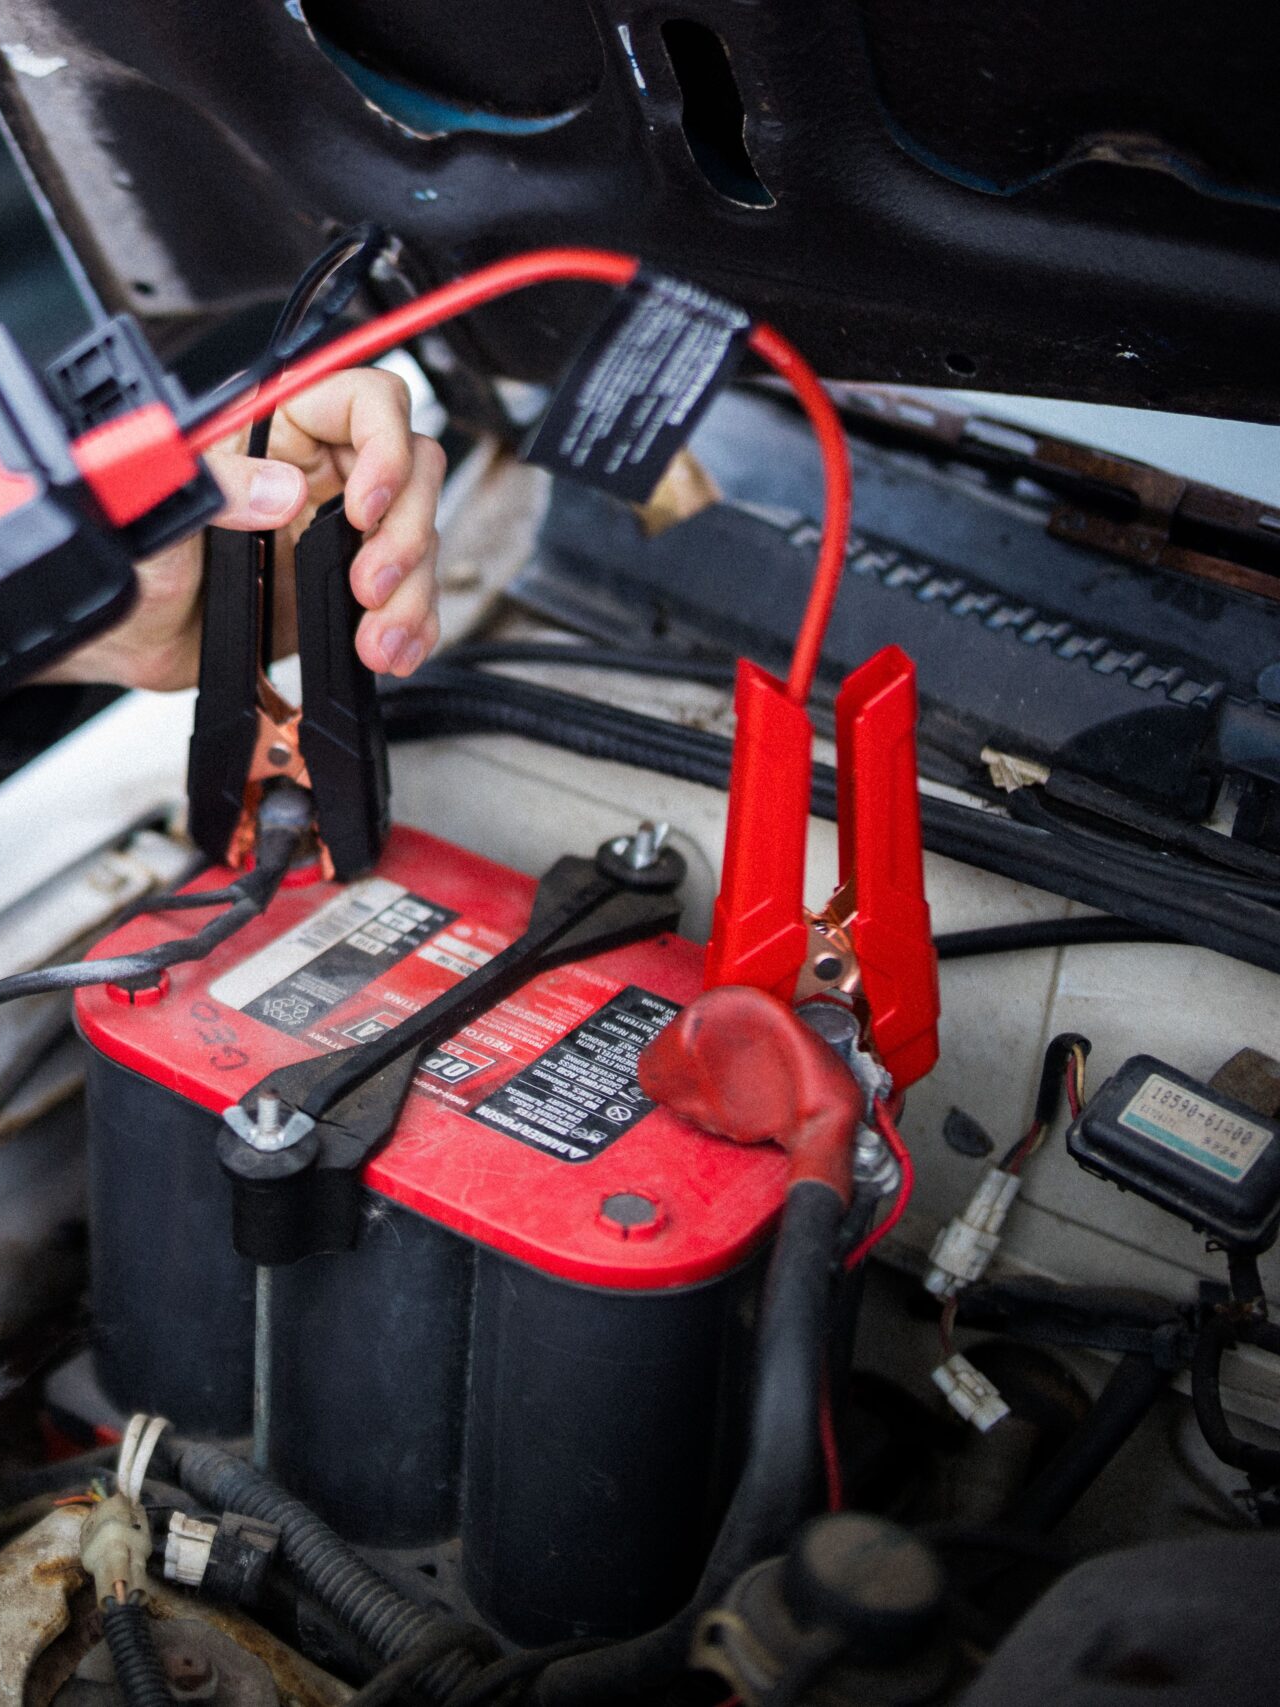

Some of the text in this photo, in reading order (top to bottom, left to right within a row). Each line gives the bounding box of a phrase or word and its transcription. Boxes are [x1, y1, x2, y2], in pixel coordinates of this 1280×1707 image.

[599, 1020, 629, 1036] REACH
[627, 1032, 645, 1042] THE
[574, 1038, 596, 1050] WITH
[577, 1031, 610, 1048] MEDICAL
[605, 1043, 624, 1055] GET
[562, 1053, 629, 1084] OR SEVERE BURNS
[593, 1053, 615, 1066] EYES
[531, 1068, 571, 1089] SMOKING
[539, 1058, 617, 1096] SULFURIC ACID CAN
[556, 1057, 623, 1090] CAUSE BLINDNESS
[504, 1086, 545, 1106] BLINDNESS
[582, 1099, 600, 1110] NO
[506, 1095, 577, 1129] EXPLOSIVE GASES
[541, 1102, 568, 1117] CAUSE
[544, 1096, 589, 1118] OR INJURY
[473, 1105, 572, 1153] DANGER/POISON
[512, 1106, 570, 1135] SHIELD EYES
